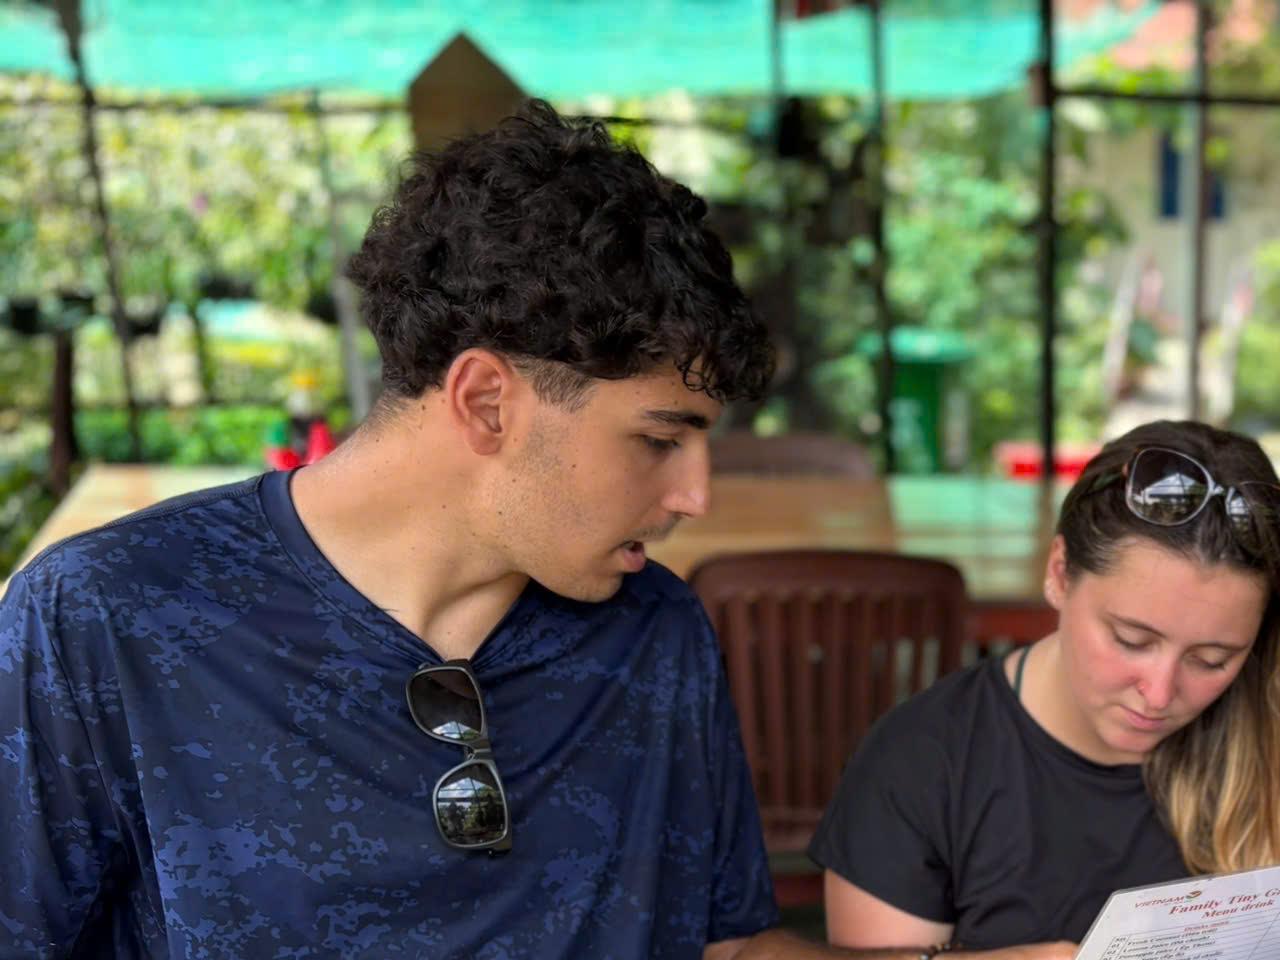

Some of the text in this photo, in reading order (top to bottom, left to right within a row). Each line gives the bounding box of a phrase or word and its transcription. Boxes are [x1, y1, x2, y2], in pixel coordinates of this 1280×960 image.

[1168, 900, 1220, 915] Family
[1228, 894, 1258, 907] Tiny
[1201, 899, 1274, 919] Menu drink
